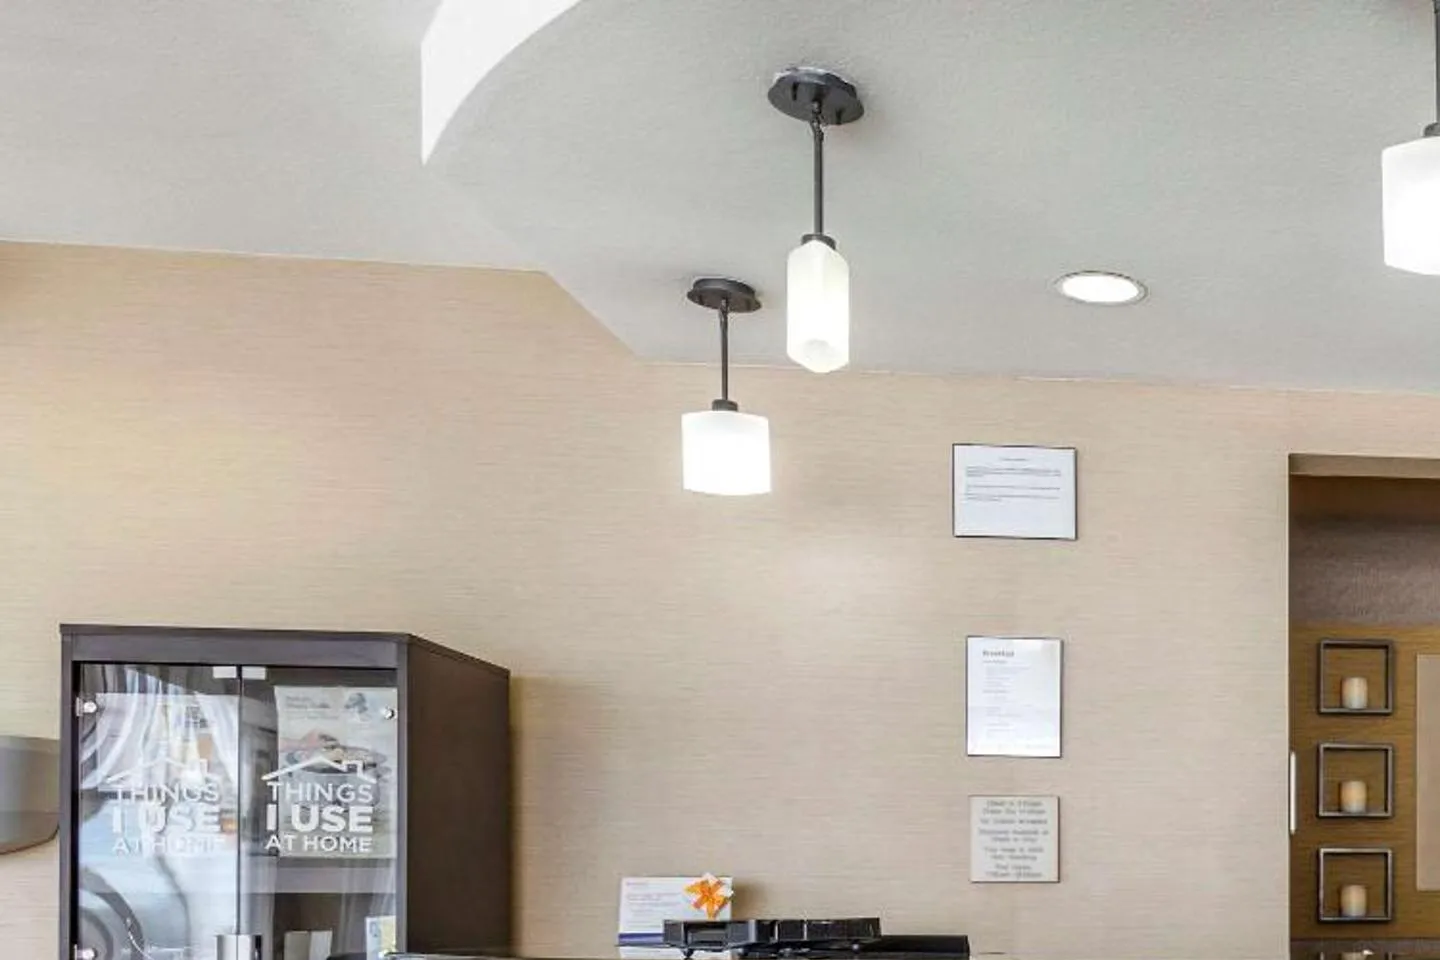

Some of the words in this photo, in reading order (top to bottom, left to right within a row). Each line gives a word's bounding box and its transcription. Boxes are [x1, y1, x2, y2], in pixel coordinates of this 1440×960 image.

[112, 783, 220, 802] THINGS
[266, 781, 374, 803] THINGS
[140, 804, 221, 834] USE
[266, 803, 277, 832] I
[291, 803, 374, 833] USE
[264, 834, 297, 852] AT
[302, 835, 373, 853] HOME
